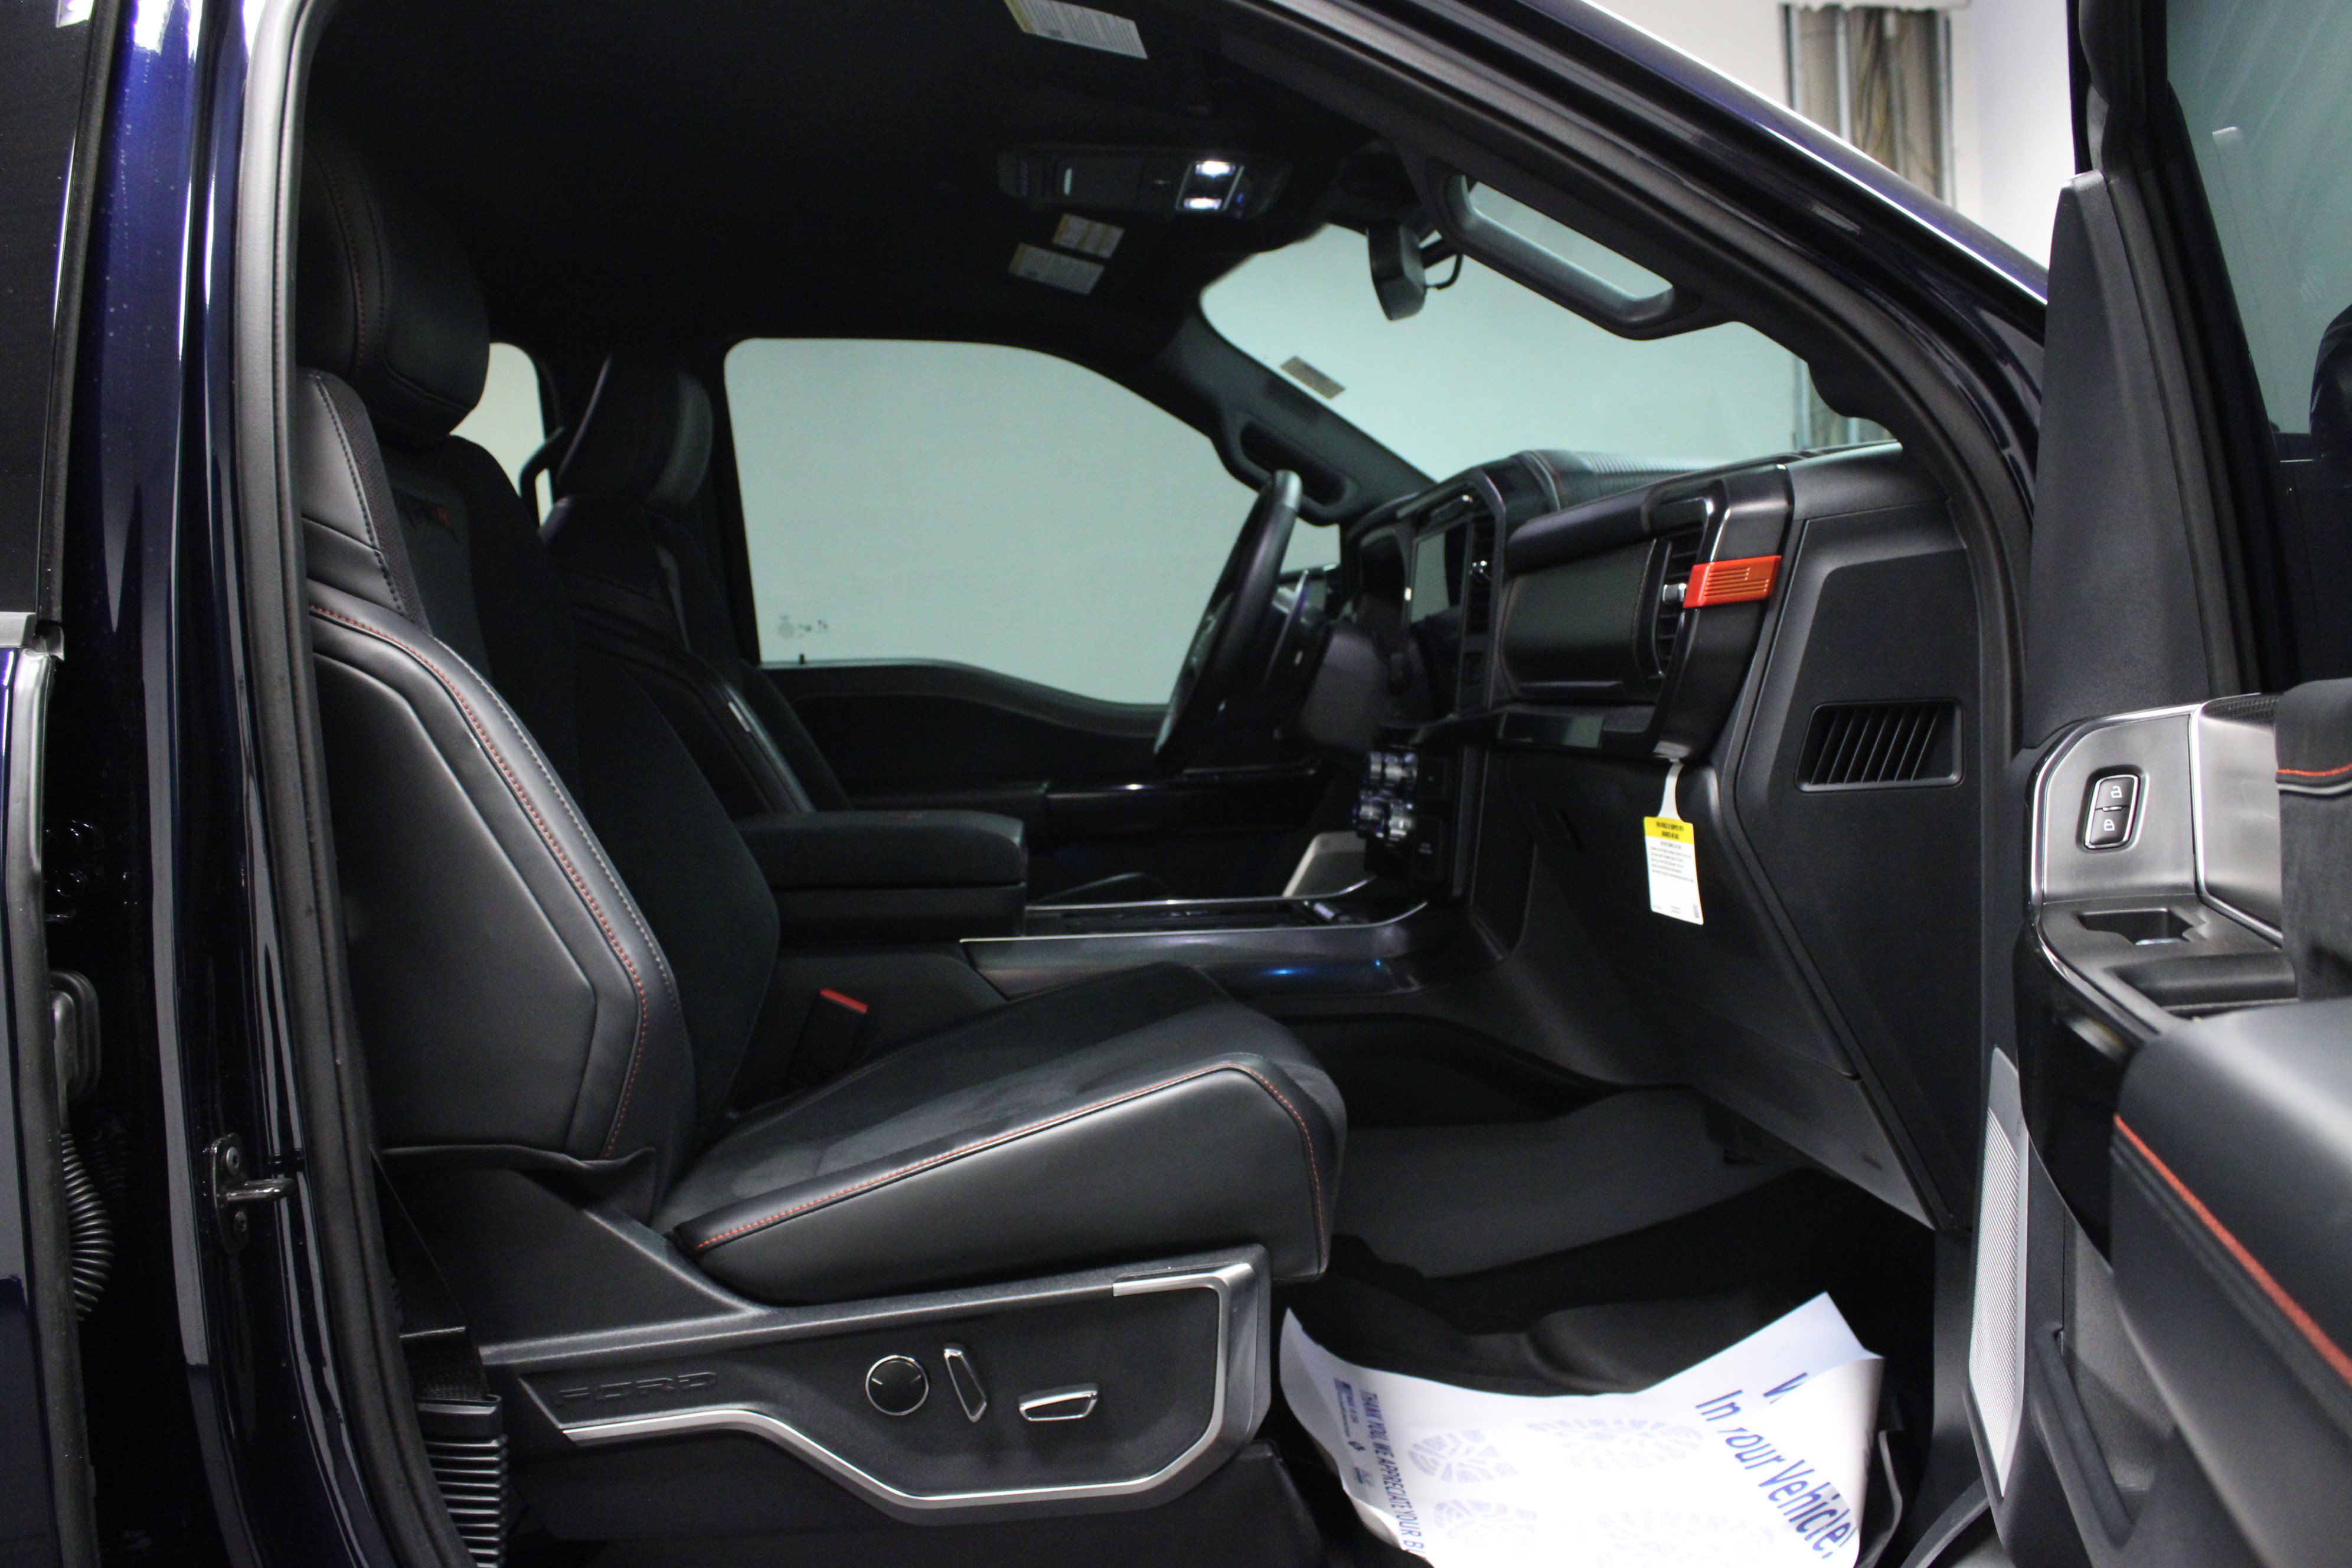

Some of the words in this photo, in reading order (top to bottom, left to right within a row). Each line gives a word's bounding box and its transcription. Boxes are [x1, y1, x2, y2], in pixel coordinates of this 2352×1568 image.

[557, 1371, 716, 1404] FORD
[1360, 1390, 1383, 1420] THANK
[1695, 1389, 1745, 1422] In
[1373, 1442, 1394, 1458] WE
[1377, 1456, 1413, 1509] APPRECIATE
[1394, 1510, 1422, 1537] YOUR
